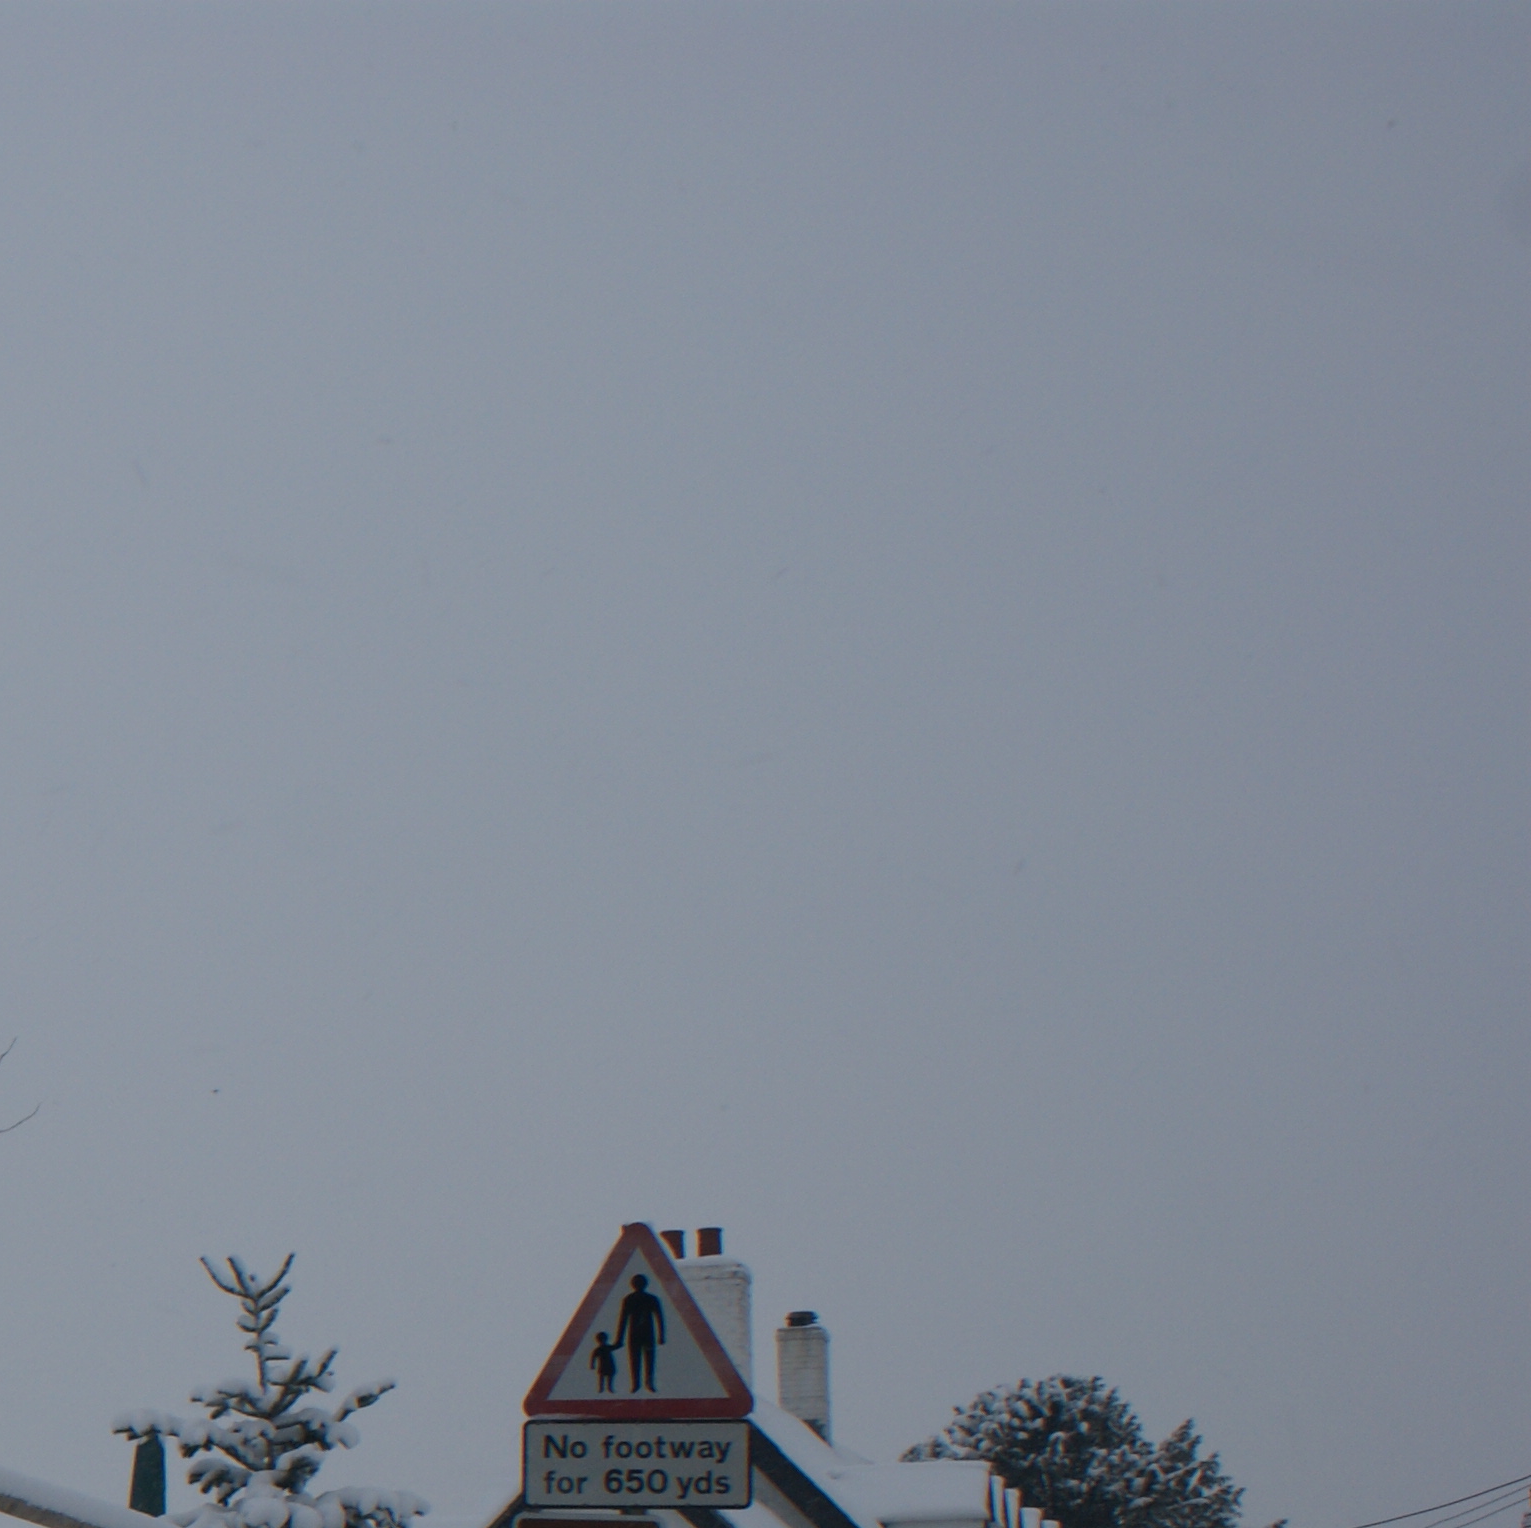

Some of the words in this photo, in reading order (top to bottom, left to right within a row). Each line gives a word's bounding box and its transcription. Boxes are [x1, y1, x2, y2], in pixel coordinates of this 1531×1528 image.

[542, 1434, 588, 1459] No
[602, 1435, 732, 1463] footway
[543, 1470, 588, 1494] for
[603, 1468, 669, 1494] 650
[676, 1470, 731, 1500] yds
